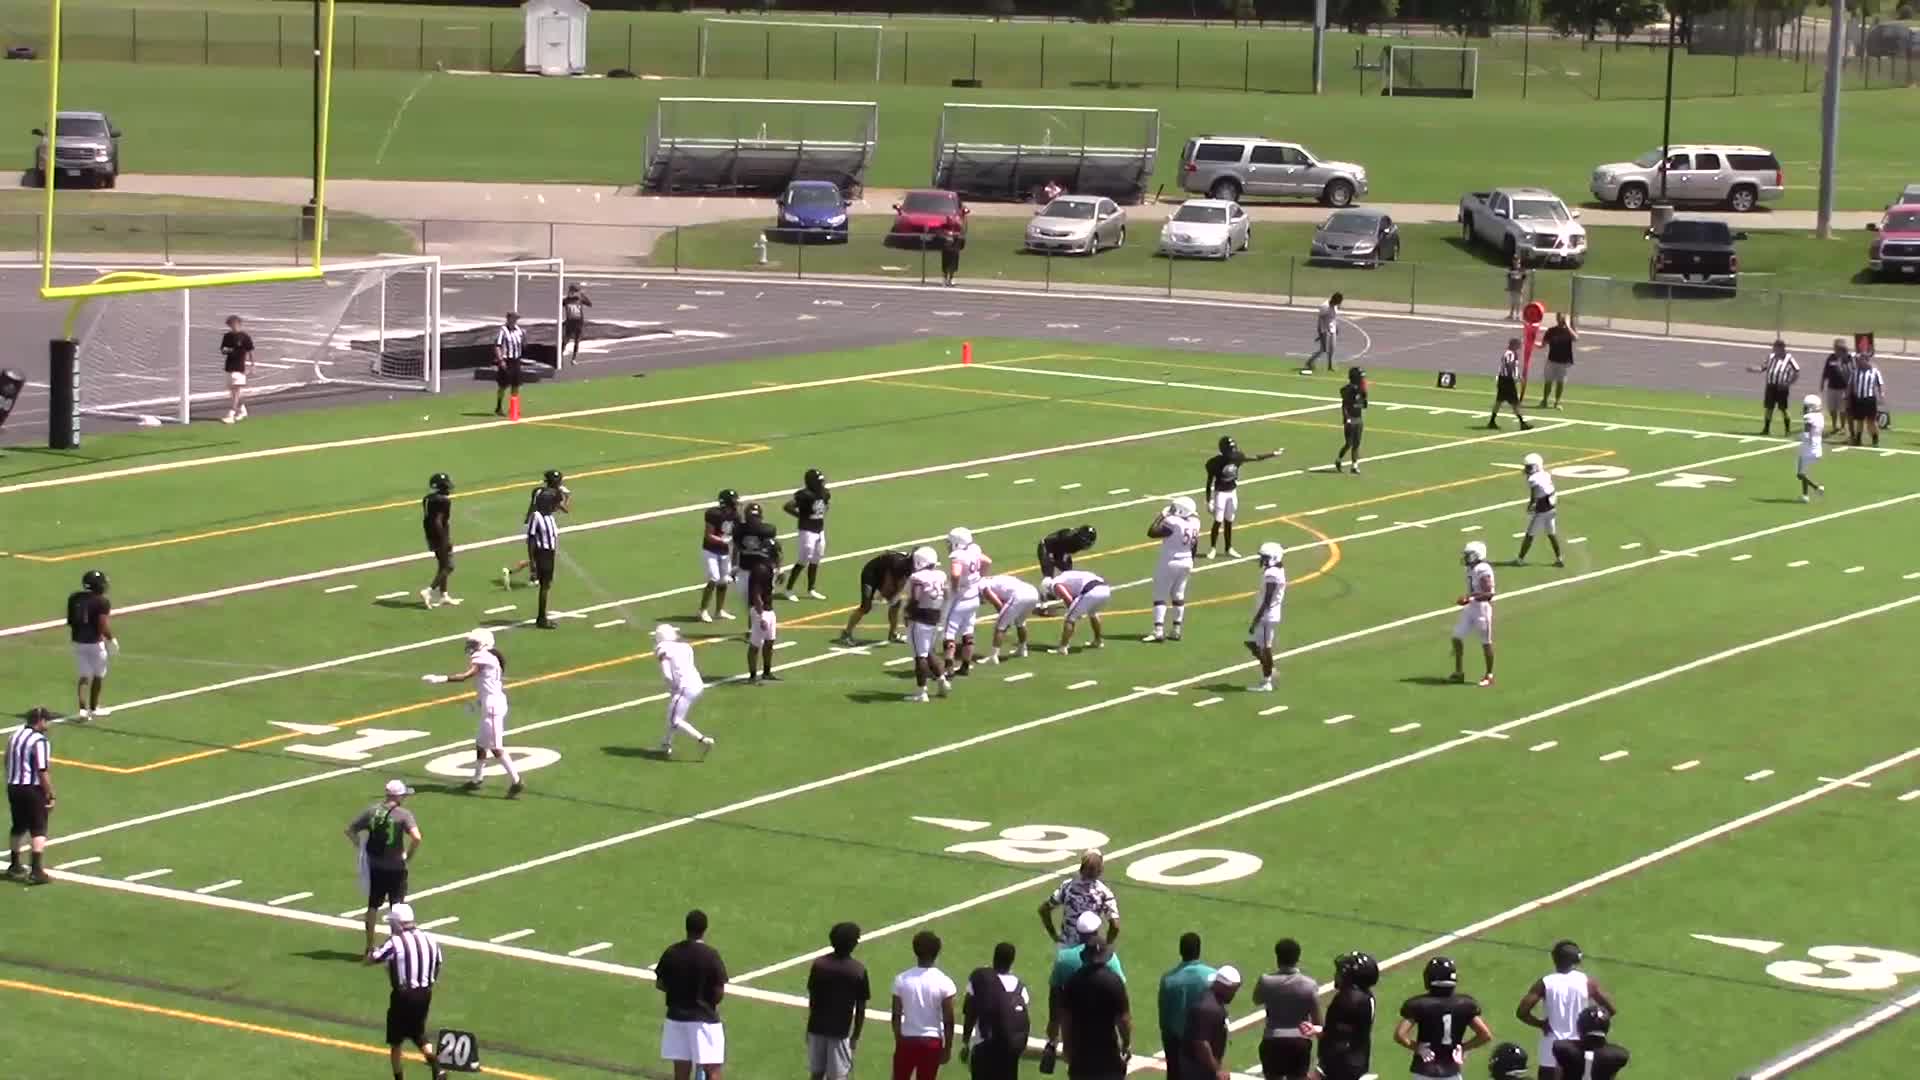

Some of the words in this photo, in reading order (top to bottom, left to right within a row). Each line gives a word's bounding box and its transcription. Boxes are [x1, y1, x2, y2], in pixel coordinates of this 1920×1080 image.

[282, 729, 562, 777] 10
[944, 824, 1264, 886] 20
[441, 1032, 472, 1066] 20
[1442, 1013, 1453, 1045] 1
